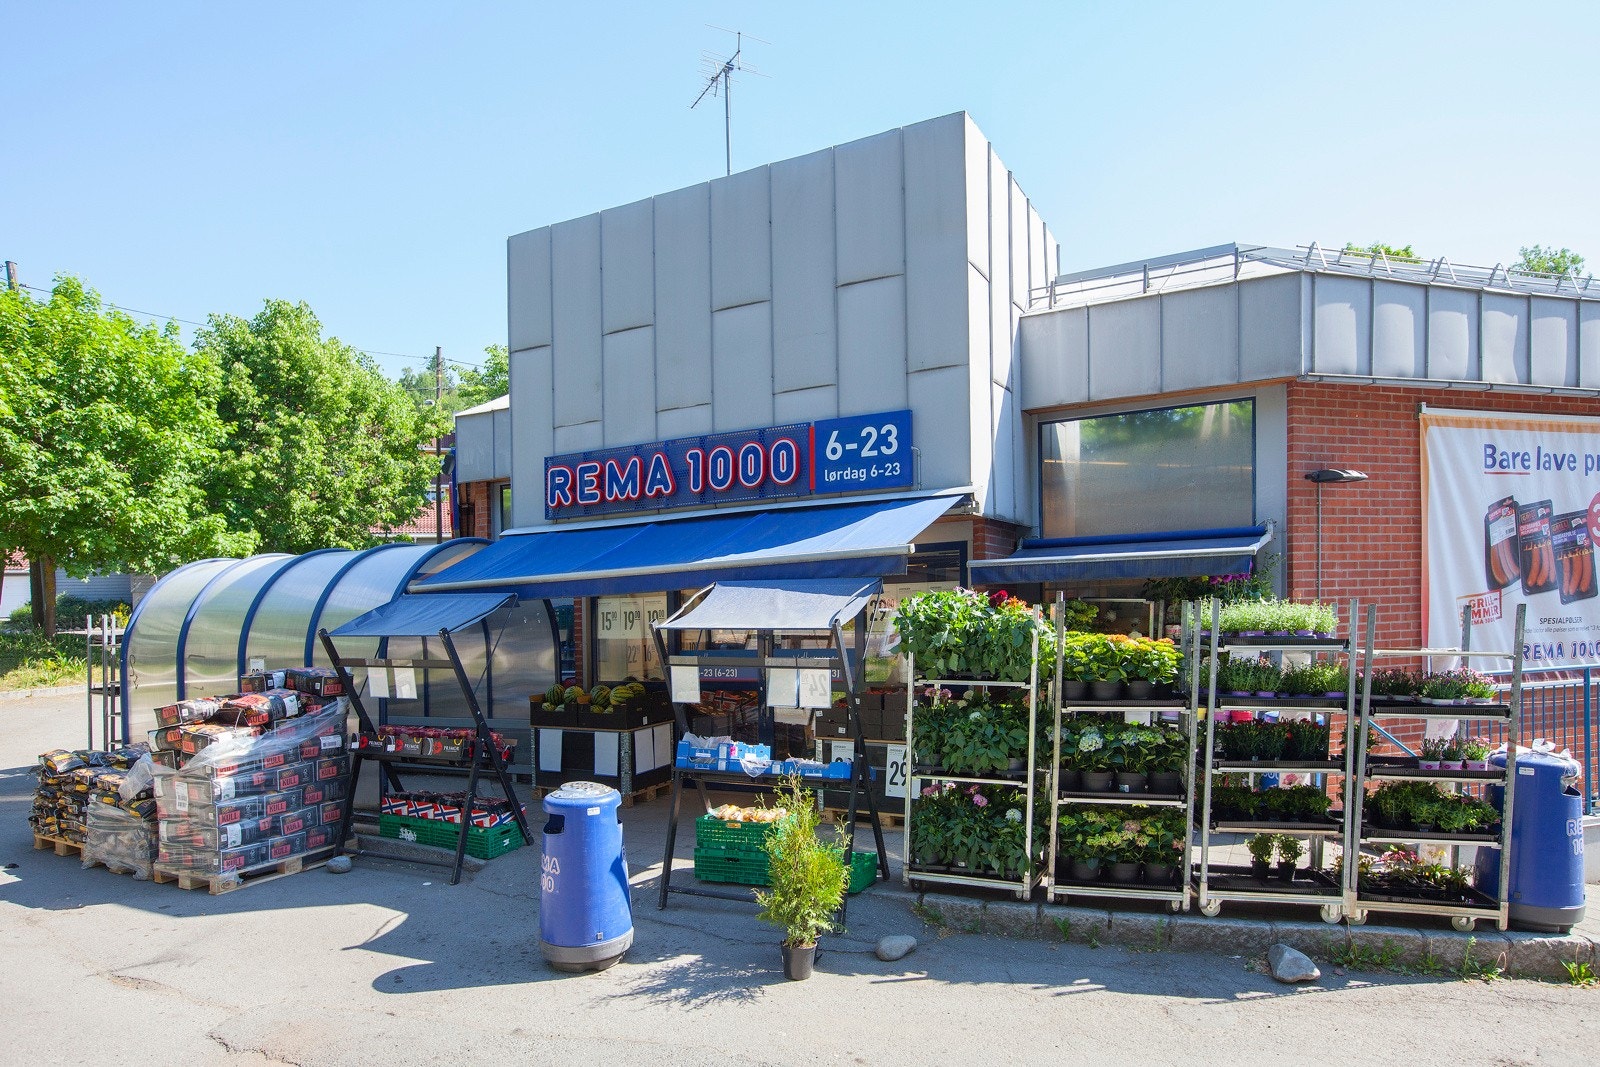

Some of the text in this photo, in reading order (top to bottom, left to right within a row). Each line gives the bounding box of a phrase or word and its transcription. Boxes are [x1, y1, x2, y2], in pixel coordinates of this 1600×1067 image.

[826, 424, 898, 461] 6-23
[1484, 444, 1531, 470] Bare
[1537, 446, 1577, 471] lave
[547, 438, 800, 507] REMA 1000
[824, 463, 901, 482] lørdag 6-23
[601, 611, 612, 631] 15
[624, 611, 635, 631] 19
[1521, 641, 1564, 661] REMA
[282, 776, 297, 787] KULL
